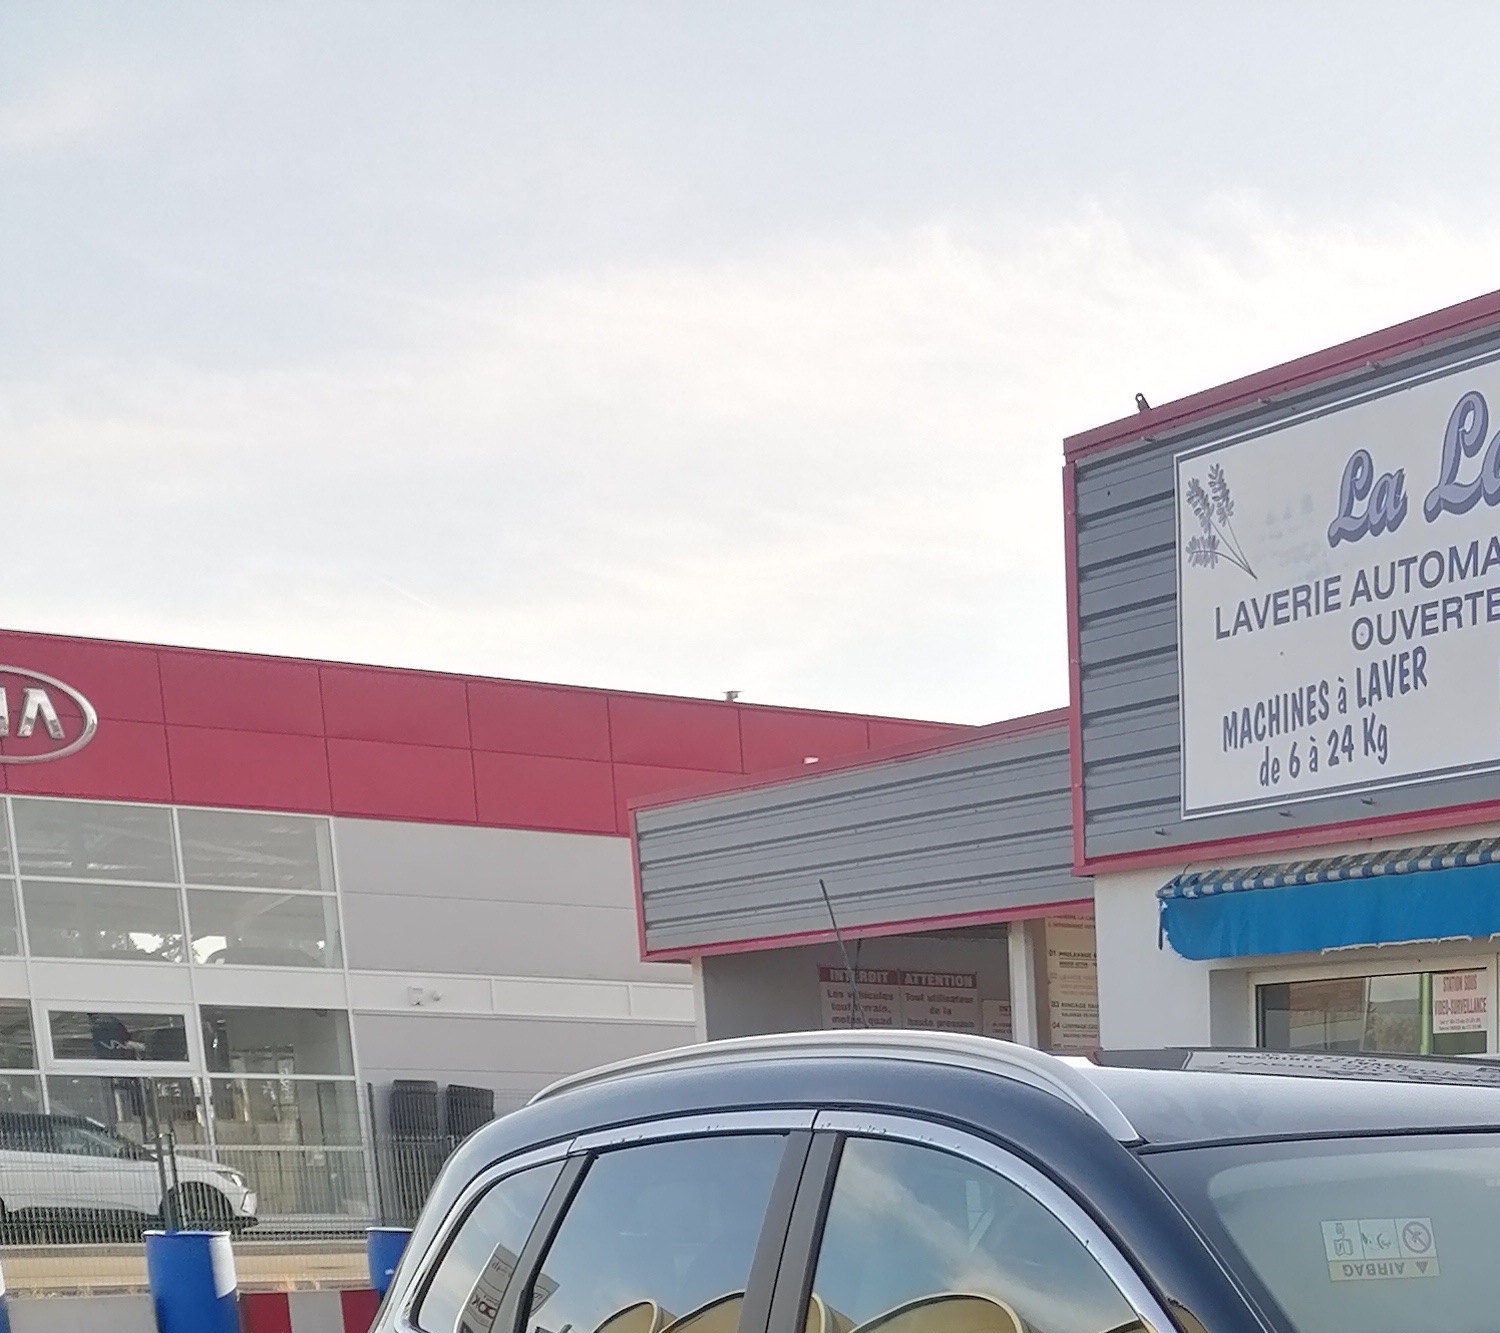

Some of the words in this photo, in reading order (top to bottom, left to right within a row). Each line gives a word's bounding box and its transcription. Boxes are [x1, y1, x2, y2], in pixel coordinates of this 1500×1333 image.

[1328, 449, 1408, 548] La
[1216, 576, 1342, 640] LAVERIE
[1223, 679, 1329, 752] MACHINES
[1337, 677, 1347, 715] à
[1357, 646, 1428, 709] LAVER
[1260, 746, 1280, 787] de
[1289, 741, 1300, 778] 6
[1309, 736, 1318, 773] à
[1327, 724, 1354, 768] 24
[1362, 712, 1388, 765] Kg
[904, 973, 973, 987] ATTENTION
[1342, 1262, 1405, 1277] AIRBAG
